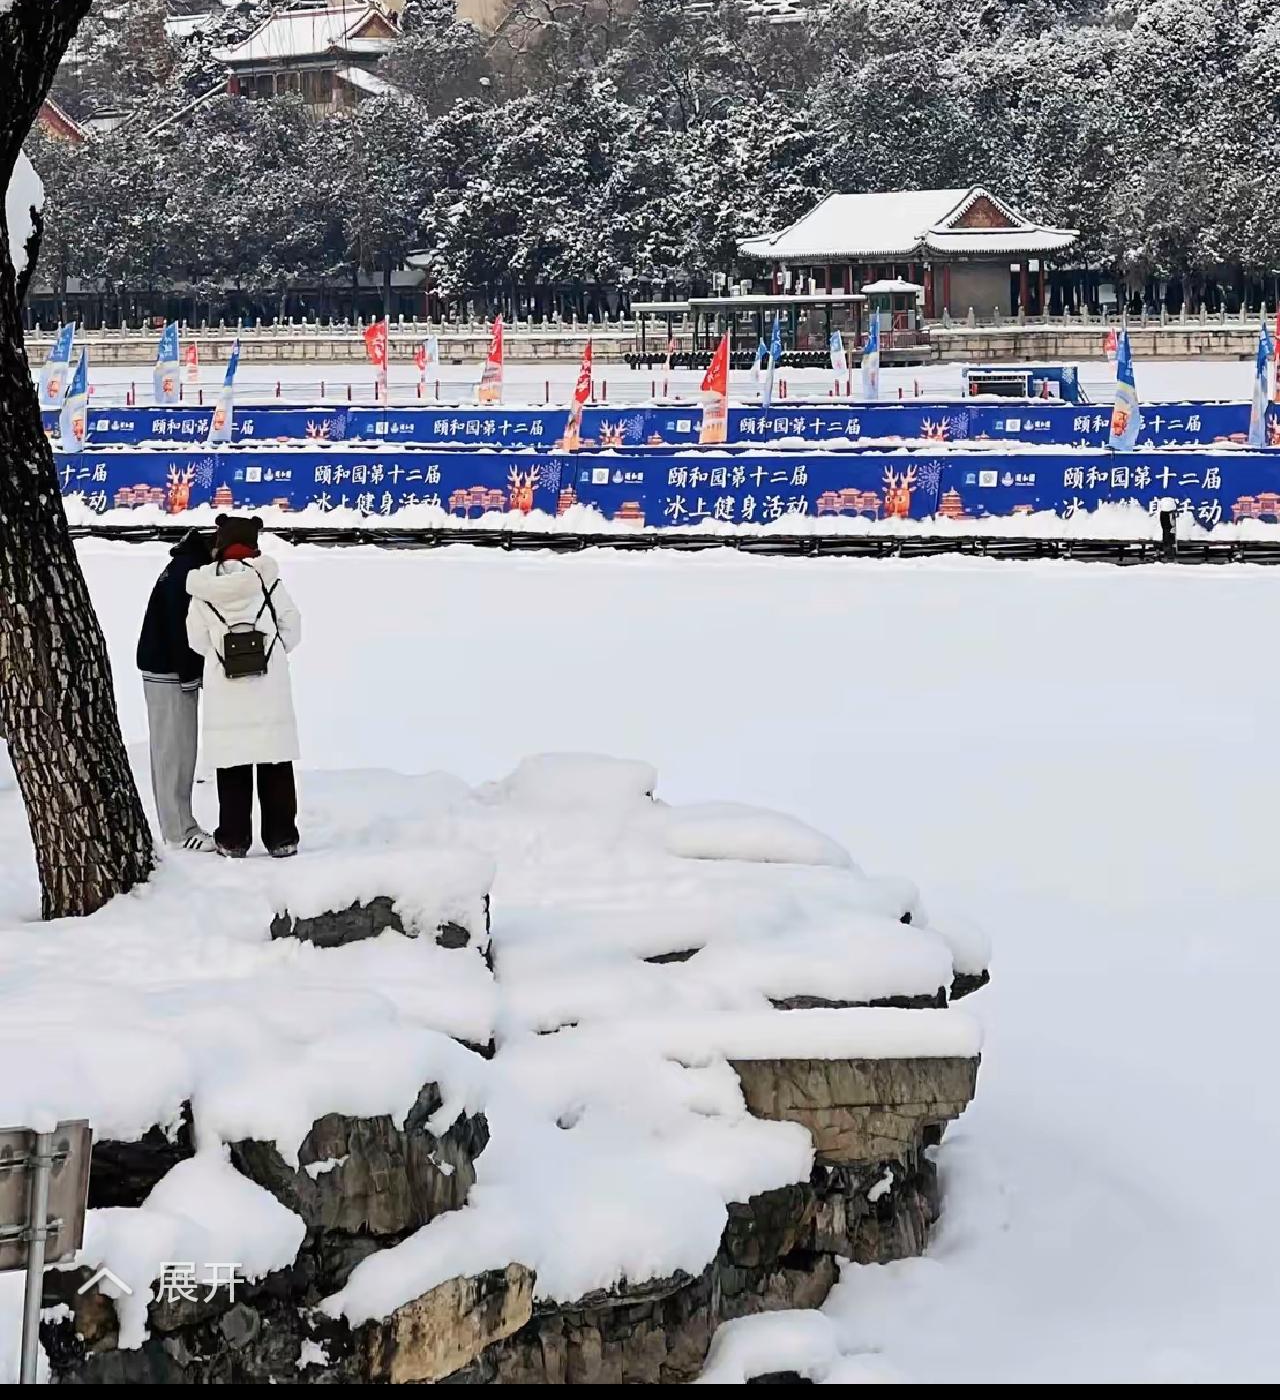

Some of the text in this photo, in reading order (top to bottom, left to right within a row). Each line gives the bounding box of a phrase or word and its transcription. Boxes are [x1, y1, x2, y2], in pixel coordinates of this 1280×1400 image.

[664, 494, 809, 520] 冰上健身活动
